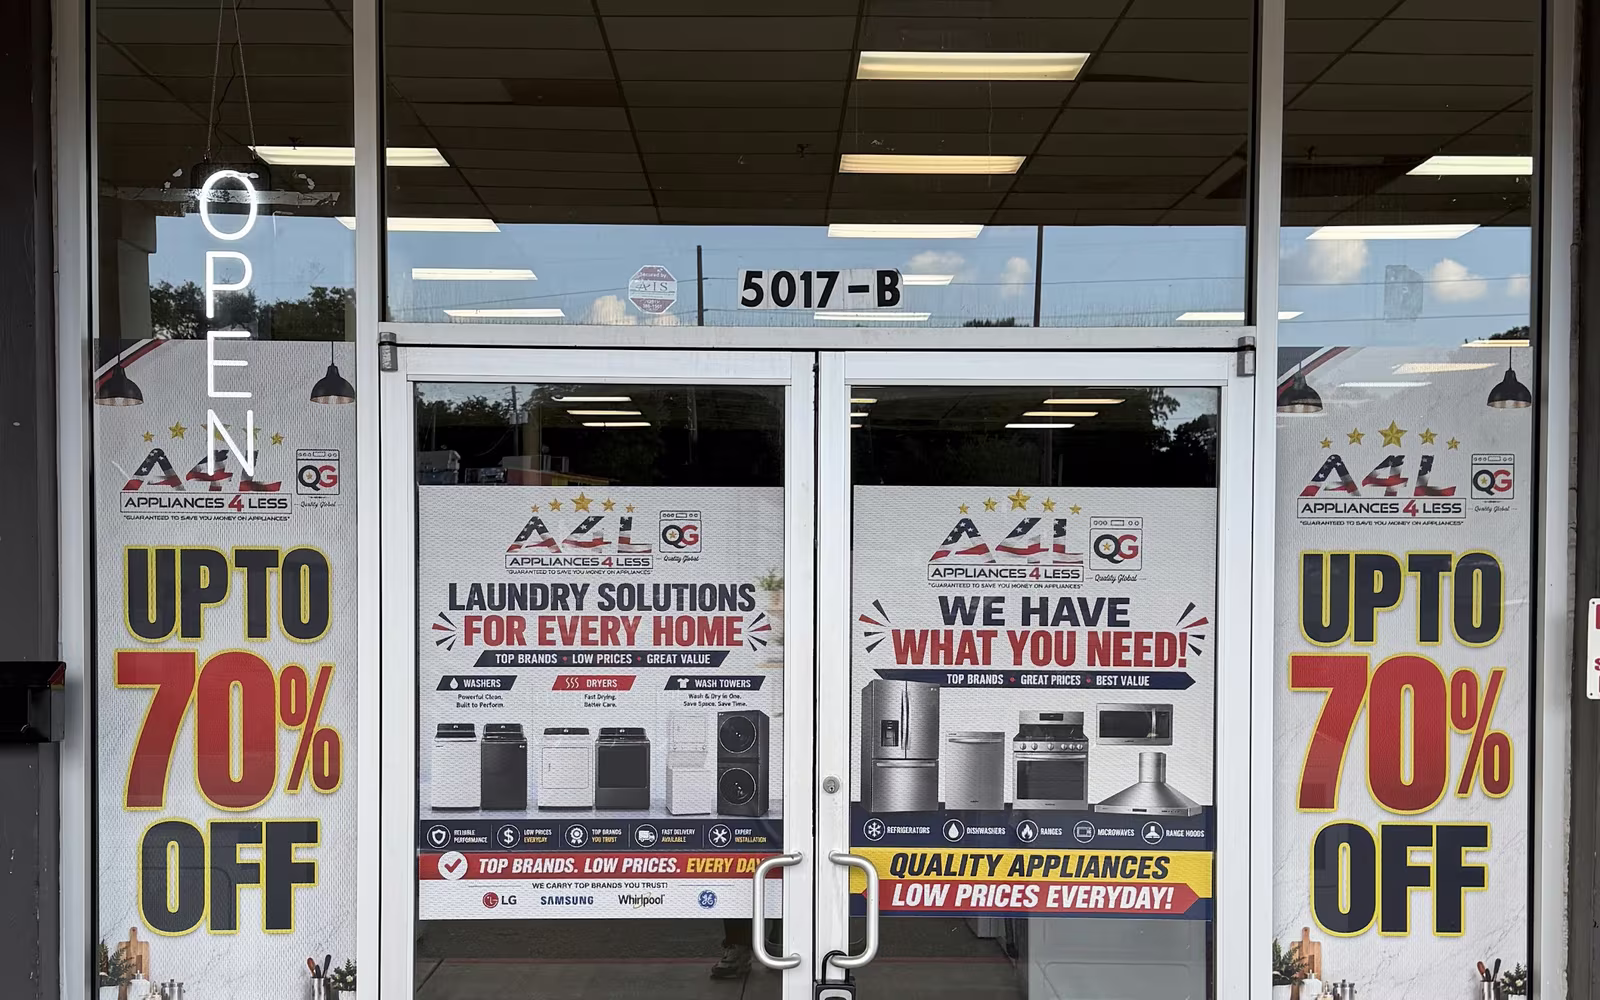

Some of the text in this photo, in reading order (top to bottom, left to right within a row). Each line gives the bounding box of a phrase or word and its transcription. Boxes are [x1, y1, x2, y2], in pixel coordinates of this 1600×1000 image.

[741, 270, 901, 308] 5017-B
[199, 169, 260, 477] OPEN
[121, 447, 283, 492] A4L
[297, 464, 339, 492] QG
[1299, 453, 1457, 497] A4L
[1472, 468, 1513, 496] QG
[124, 494, 288, 512] APPLIANCES 4 LESS
[300, 500, 318, 508] Quality
[1301, 500, 1462, 517] APPLIANCES 4 LESS
[1474, 505, 1511, 513] Quality Global
[506, 516, 653, 553] A4L
[662, 524, 700, 549] QG
[928, 517, 1084, 564] A4L
[1093, 533, 1140, 564] QG
[510, 556, 650, 568] APPLIANCES 4 LESS
[664, 555, 700, 564] Quality Global
[930, 568, 1080, 580] APPLIANCES 4 LESS
[1094, 574, 1138, 584] Quality Global
[125, 546, 331, 642] UP TO
[448, 582, 756, 612] LAUNDRY SOLUTIONS
[1301, 551, 1503, 645] UP TO
[938, 596, 1130, 627] WE HAVE
[464, 614, 744, 646] FOR EVERY HOME
[495, 654, 711, 664] TOP BRANDS LOW PRICES GREAT VALUE
[891, 629, 1188, 668] WHAT YOU NEED!
[463, 678, 502, 688] WASHERS
[586, 679, 618, 688] DRYERS
[694, 680, 752, 688] WASH TOWERS
[946, 674, 1150, 686] TOP BRANDS GREAT PRICES BEST VALUE
[597, 694, 617, 702] Drying.
[115, 649, 342, 811] 70%
[1290, 653, 1514, 814] 70%
[886, 826, 931, 834] REFRIGERATORS
[966, 827, 1006, 835] DISHWASHERS
[1097, 828, 1135, 837] MICROWAVES
[1166, 830, 1205, 838] RANGE HOODS
[479, 858, 509, 874] TOP
[512, 858, 578, 874] BRANDS.
[584, 858, 618, 874] LOW
[622, 858, 681, 874] PRICES.
[686, 858, 734, 874] EVERY
[890, 852, 1170, 880] QUALITY APPLIANCES
[140, 818, 319, 936] OFF
[1311, 820, 1490, 936] OFF
[502, 895, 517, 905] LG
[540, 896, 594, 906] SAMSUNG
[618, 892, 665, 908] Whirlpool
[892, 884, 1175, 910] LOW PRICES EVERYDAY!
